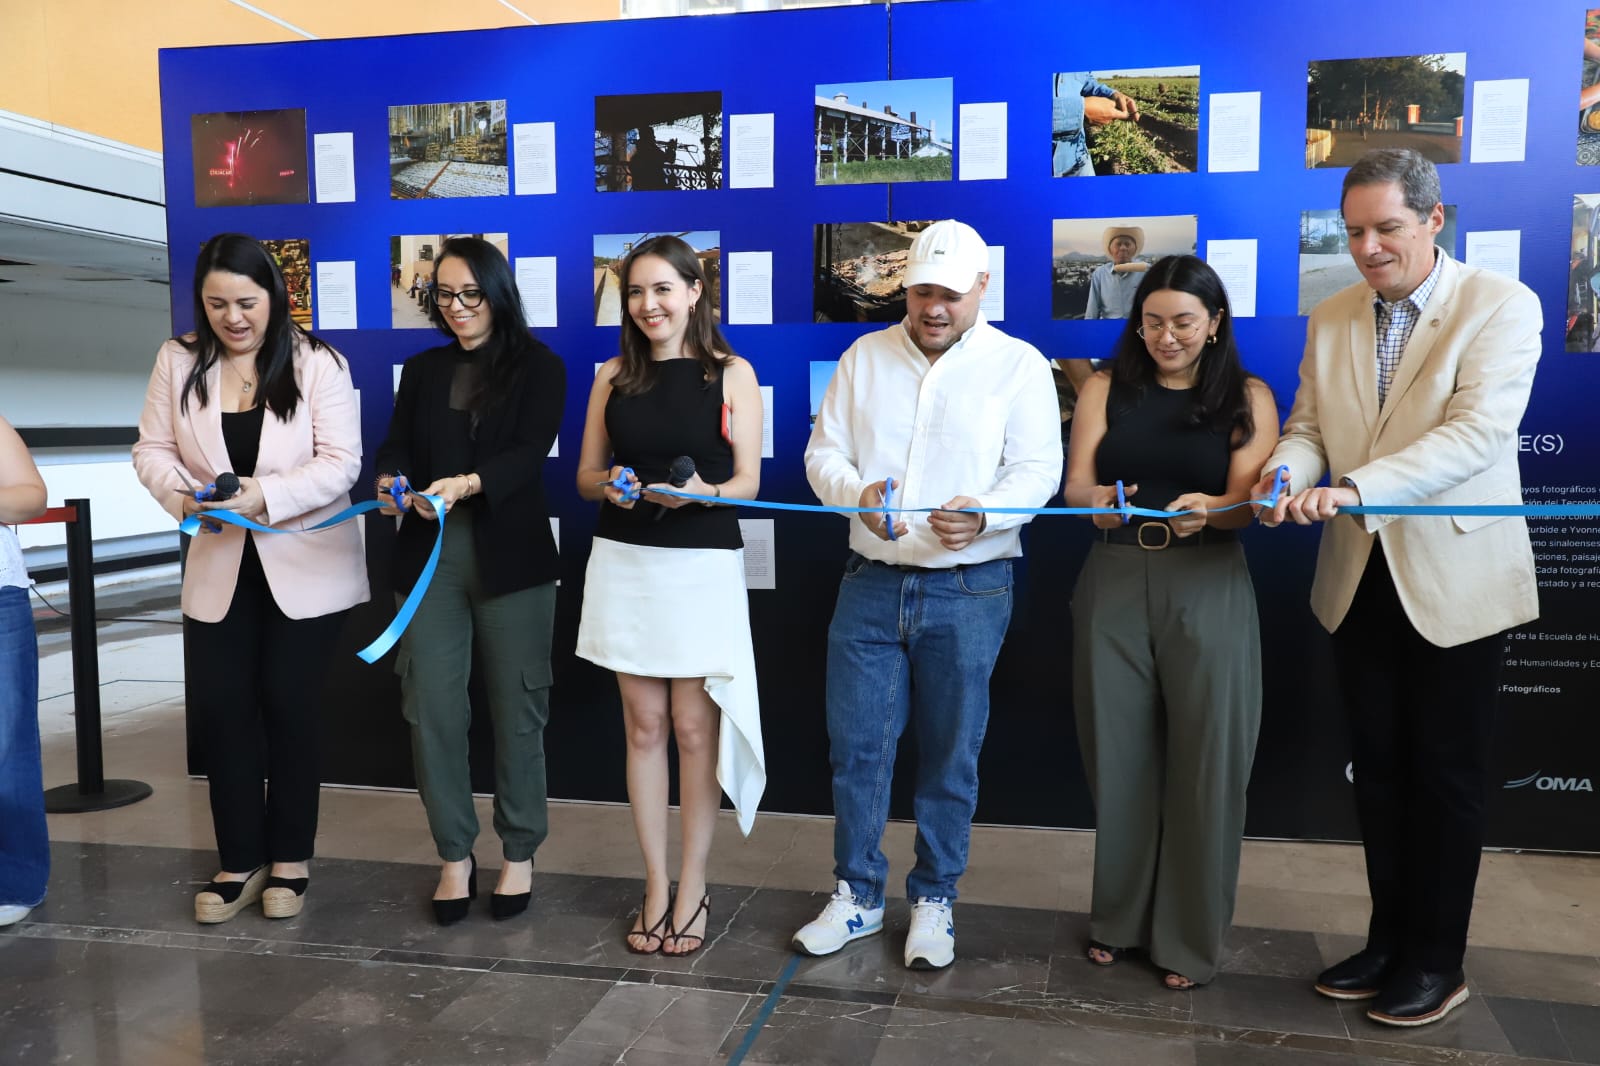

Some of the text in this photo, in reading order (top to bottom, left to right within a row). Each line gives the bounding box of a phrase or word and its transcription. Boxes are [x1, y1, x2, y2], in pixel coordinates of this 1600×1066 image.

[1542, 485, 1596, 494] fotográficos
[1535, 566, 1558, 574] Cada
[1538, 580, 1569, 588] estado
[1515, 632, 1527, 640] de
[1529, 632, 1537, 640] la
[1539, 633, 1573, 641] Escuela
[1575, 633, 1587, 641] de
[1506, 659, 1518, 667] de
[1520, 659, 1580, 668] Humanidades
[1582, 661, 1588, 669] y
[1503, 684, 1561, 694] Fotográficos
[1535, 776, 1593, 792] OMA
